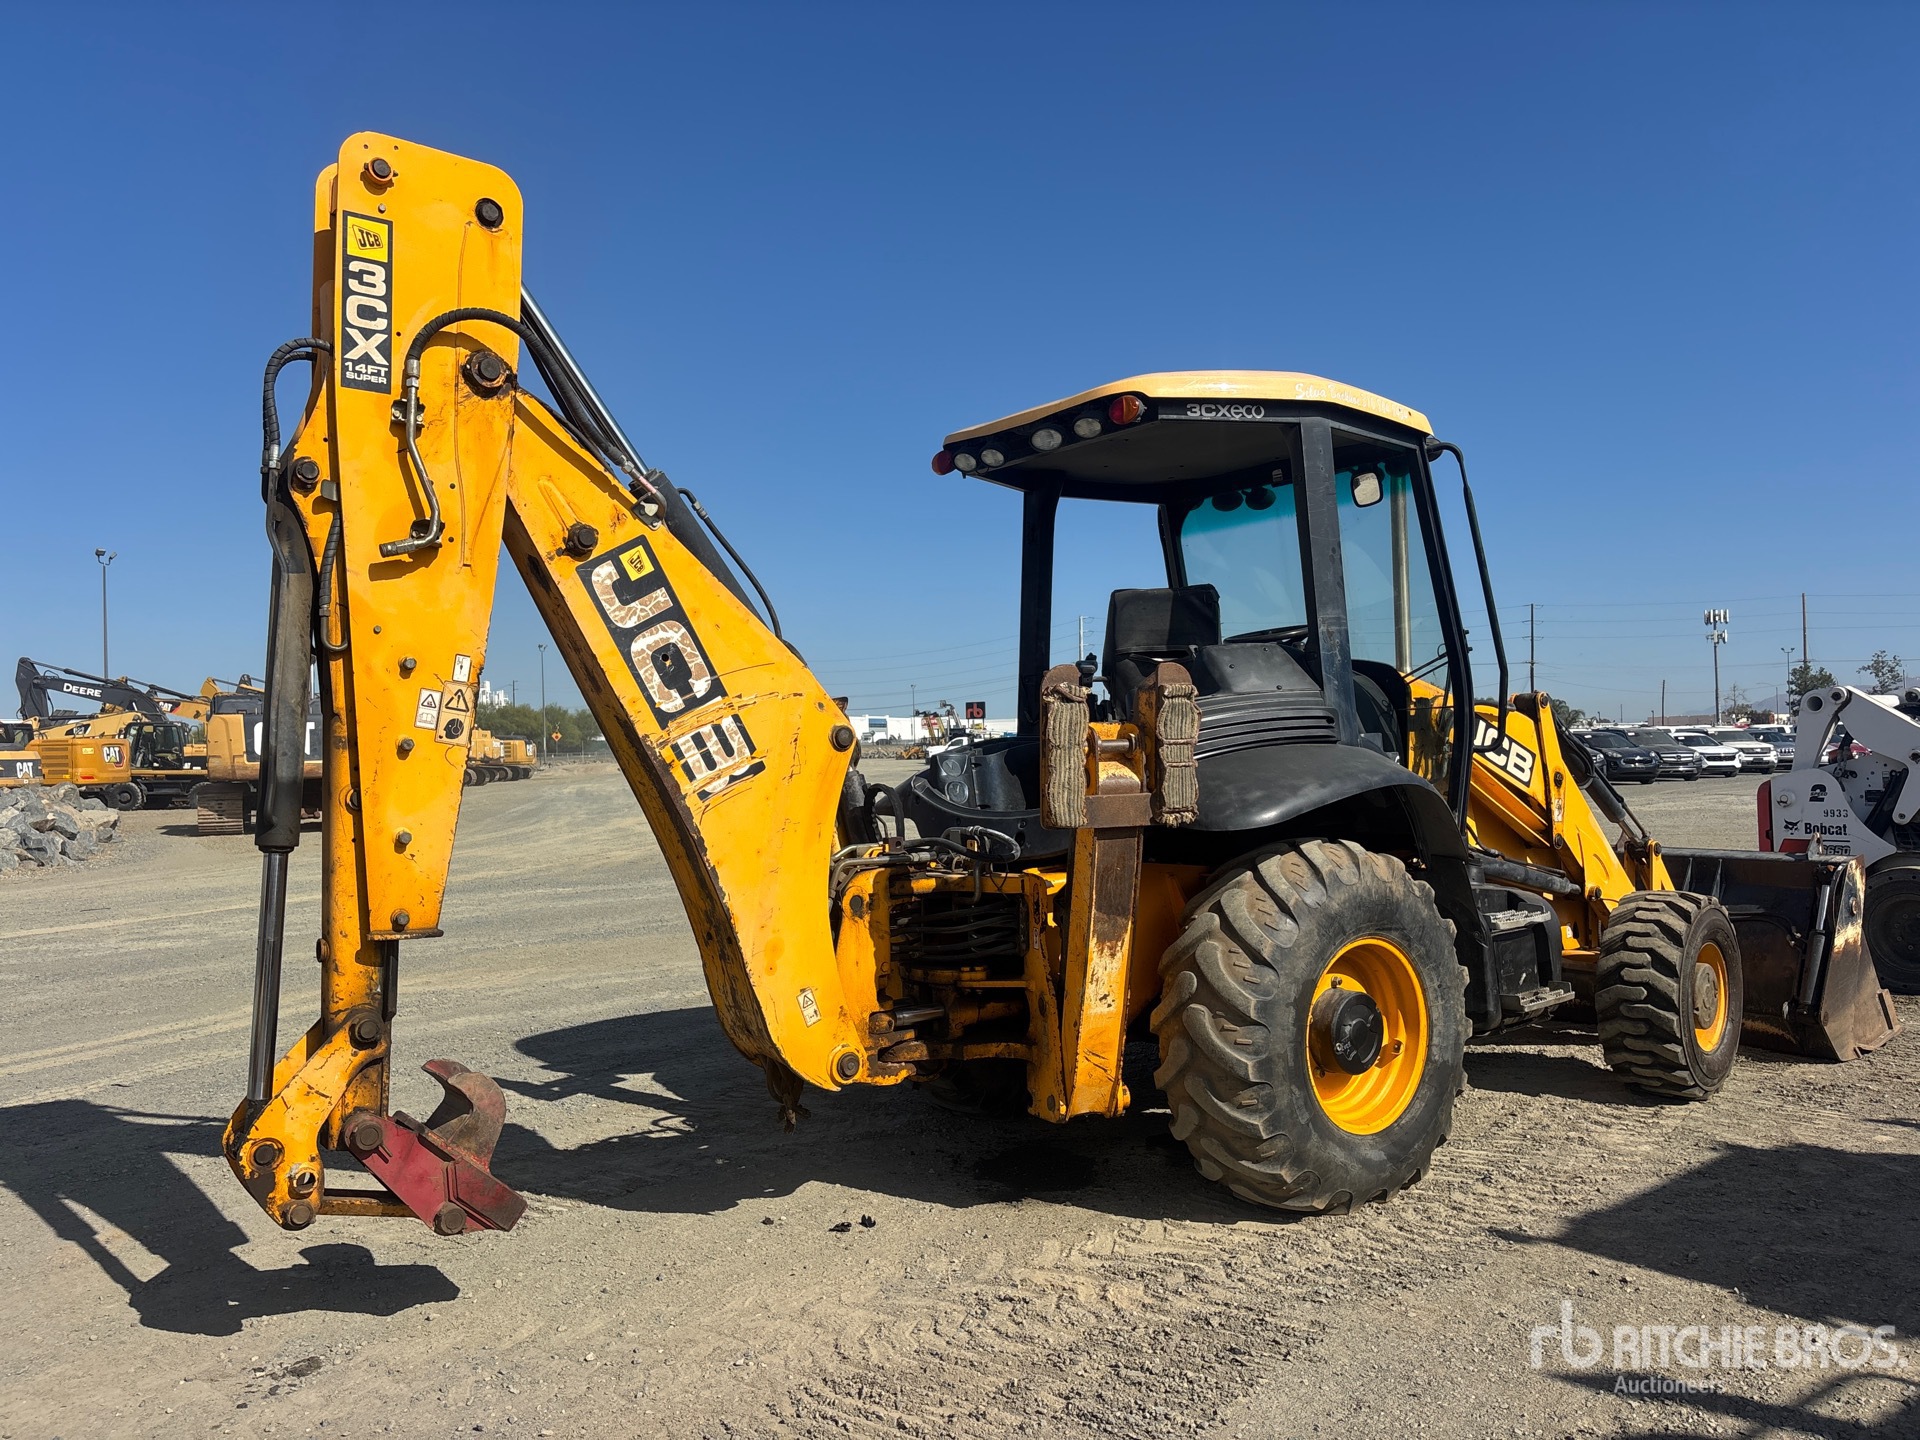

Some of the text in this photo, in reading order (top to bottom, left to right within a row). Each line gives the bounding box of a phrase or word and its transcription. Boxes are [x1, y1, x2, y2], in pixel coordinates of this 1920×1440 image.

[358, 228, 381, 248] JCB
[343, 260, 390, 366] 3CX
[344, 361, 389, 377] 14FT
[345, 371, 387, 385] SUPER
[630, 555, 644, 573] JCB
[63, 682, 102, 698] DEERE
[967, 703, 984, 718] rb
[103, 746, 120, 763] CAT
[16, 762, 33, 778] CAT
[1823, 808, 1849, 818] 9933
[1804, 822, 1848, 836] Bobcat
